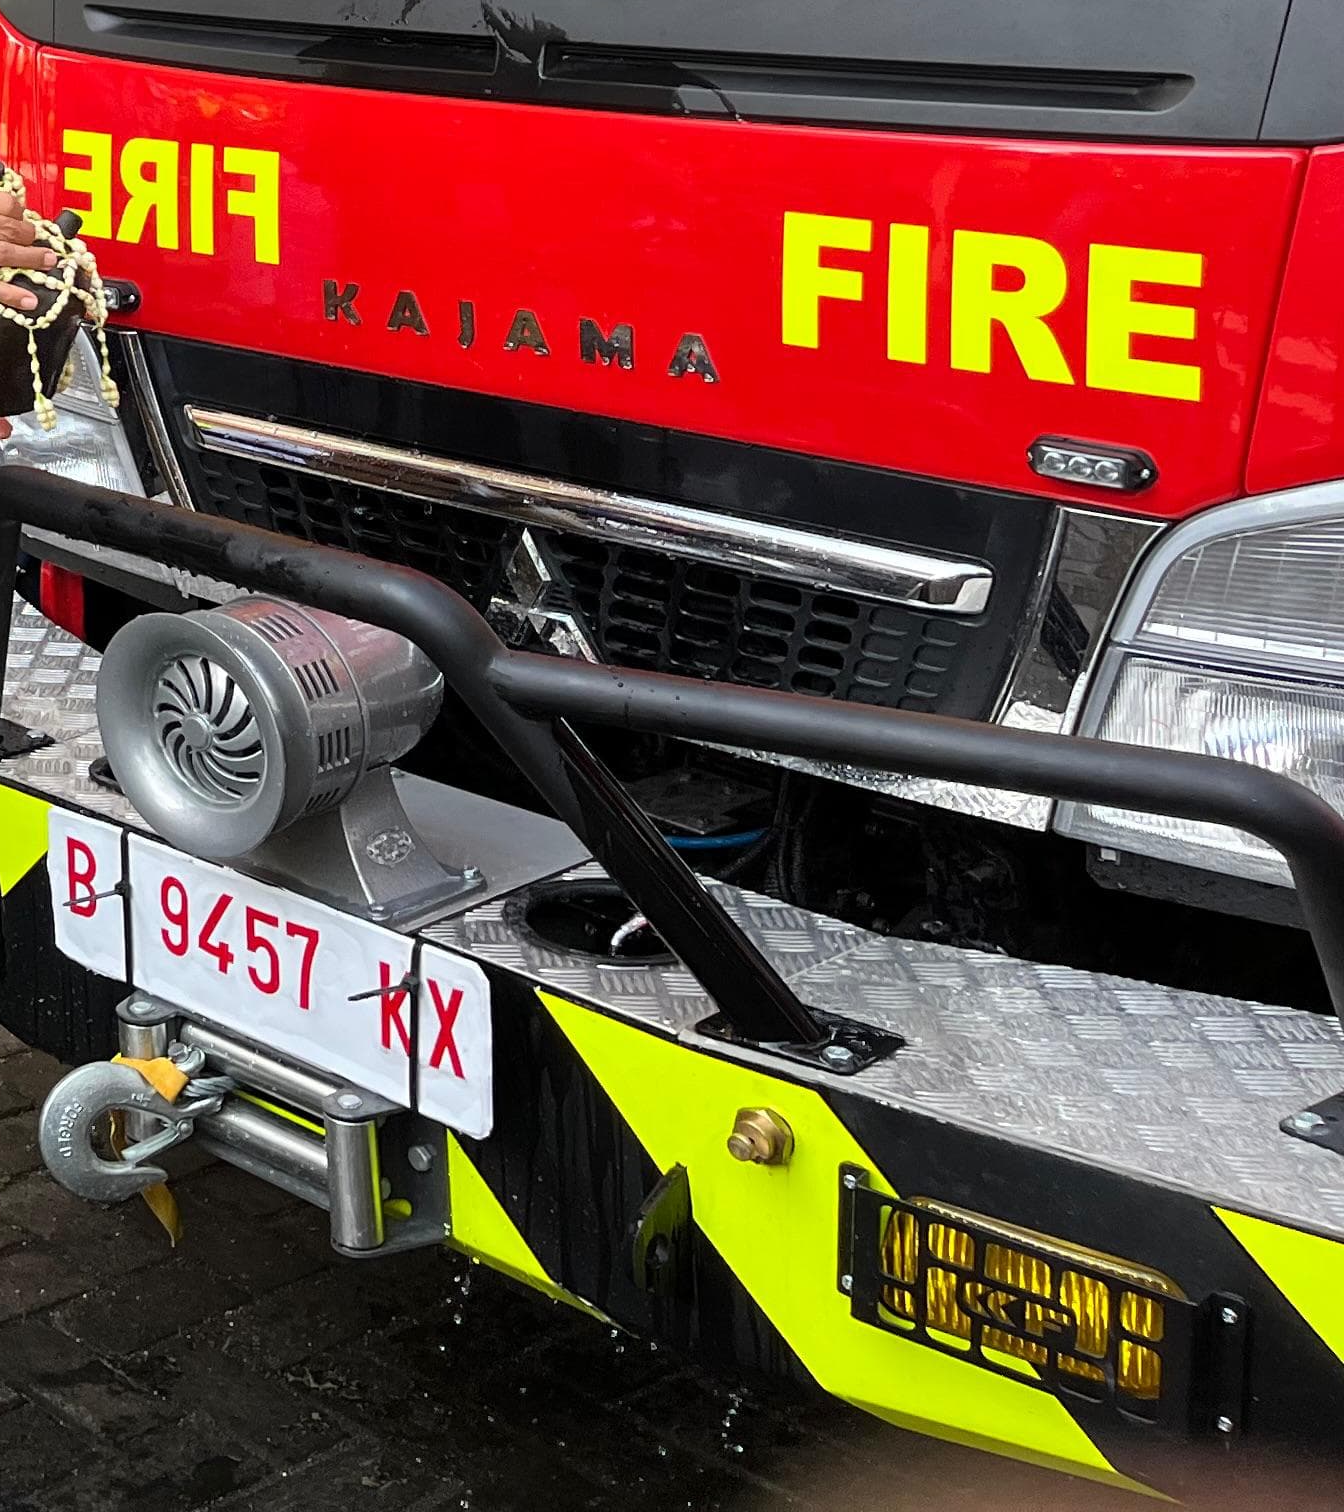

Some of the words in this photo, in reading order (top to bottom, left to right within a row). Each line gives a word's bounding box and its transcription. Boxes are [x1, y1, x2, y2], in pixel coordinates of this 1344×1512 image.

[322, 279, 721, 384] KAJAMA
[782, 211, 1203, 402] FIRE
[67, 837, 97, 918] B
[161, 876, 319, 1010] 9457
